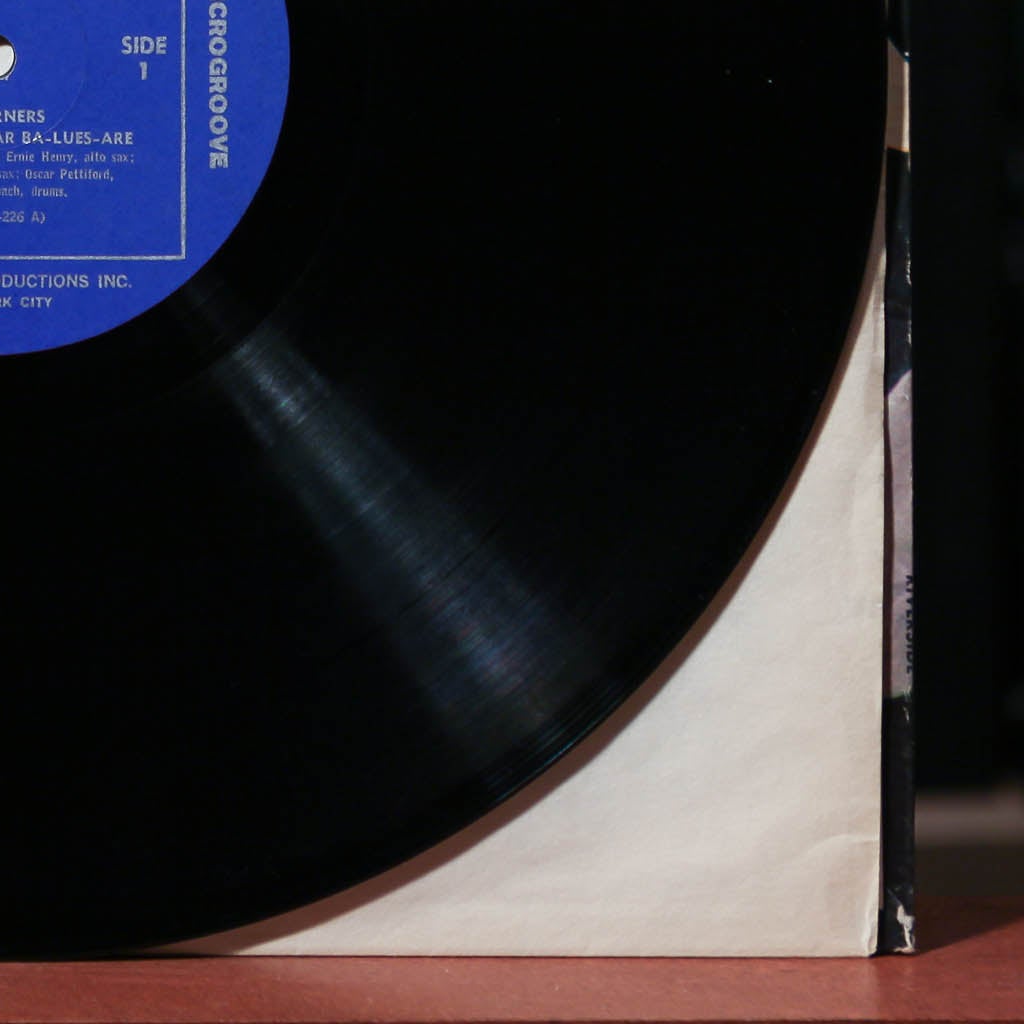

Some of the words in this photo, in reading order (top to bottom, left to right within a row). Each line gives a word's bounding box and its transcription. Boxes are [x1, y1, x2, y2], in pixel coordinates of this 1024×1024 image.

[121, 35, 167, 55] SIDE
[139, 61, 148, 81] 1
[21, 131, 134, 145] BA-LUES-ARE
[6, 151, 35, 163] Ernie
[83, 151, 107, 163] alto
[25, 168, 55, 180] Oscar
[31, 210, 46, 225] A)
[98, 274, 133, 289] INC.
[20, 296, 53, 308] CITY
